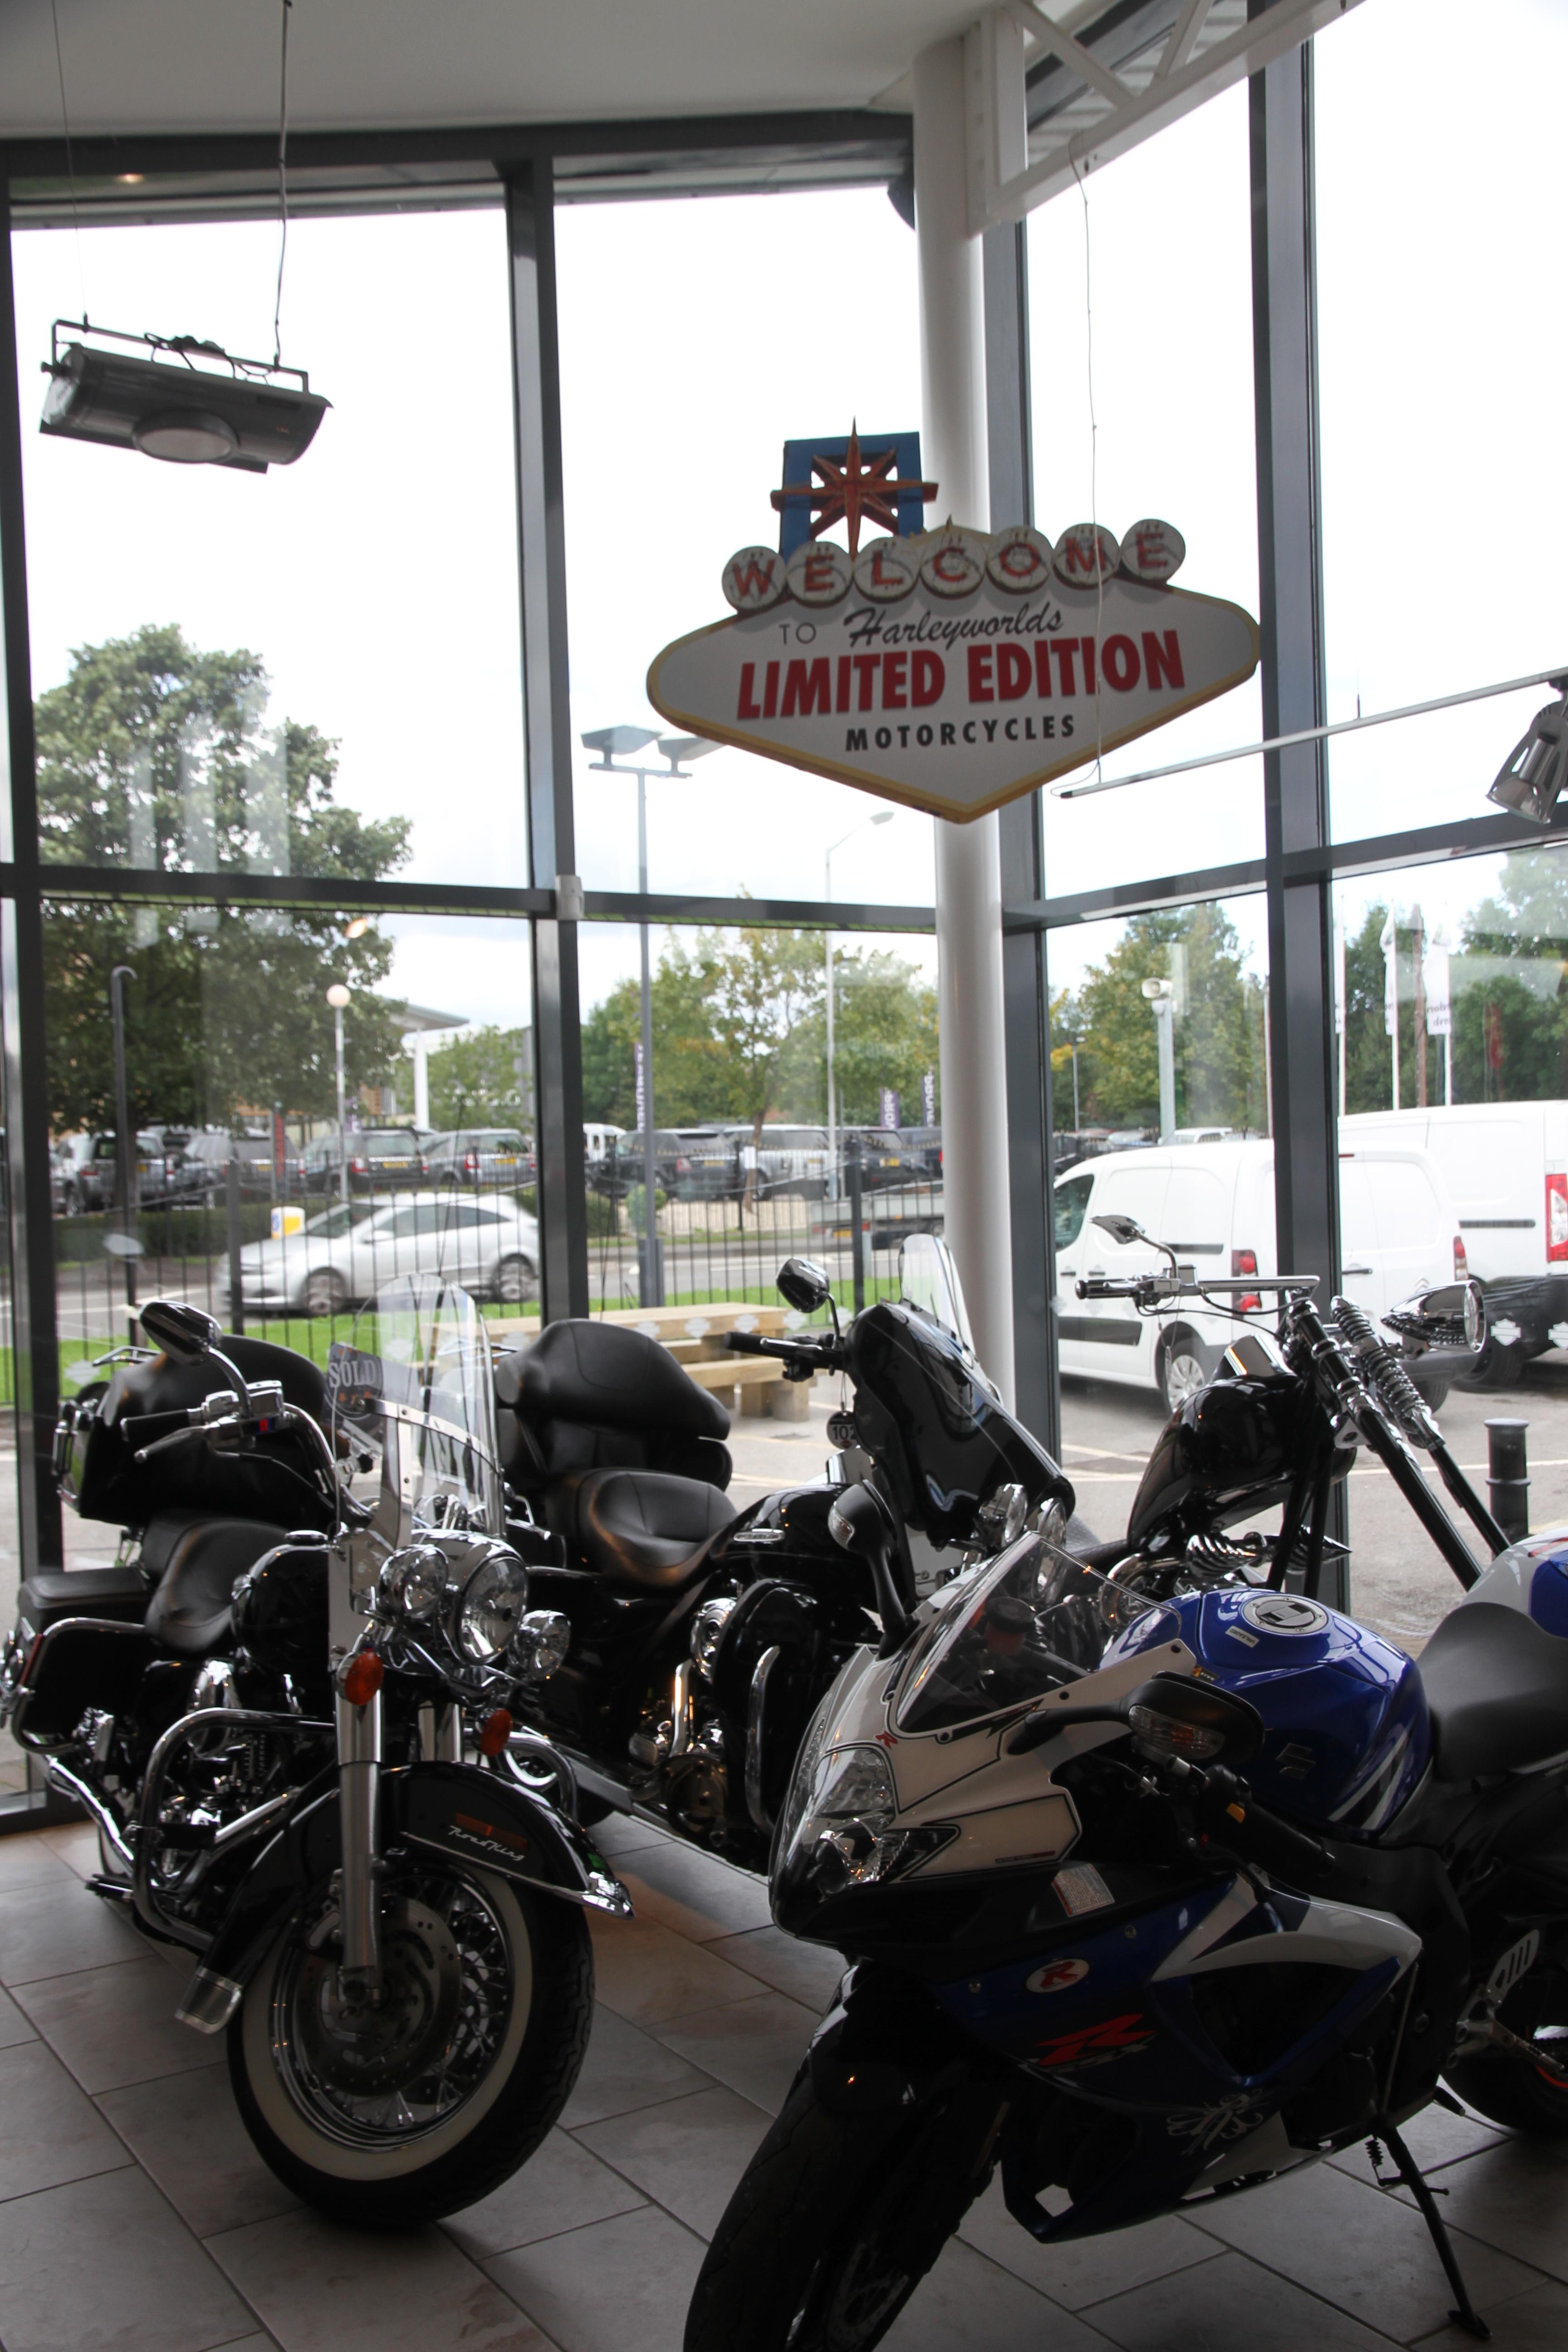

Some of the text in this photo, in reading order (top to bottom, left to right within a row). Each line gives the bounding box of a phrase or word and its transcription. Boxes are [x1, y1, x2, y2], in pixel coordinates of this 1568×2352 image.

[731, 532, 1168, 598] WELCOME
[779, 601, 1064, 650] TO Harleyworlds
[737, 630, 1185, 720] LIMITED EDITION
[845, 715, 1075, 752] MOTORCYCLES
[328, 1360, 377, 1388] SOLD
